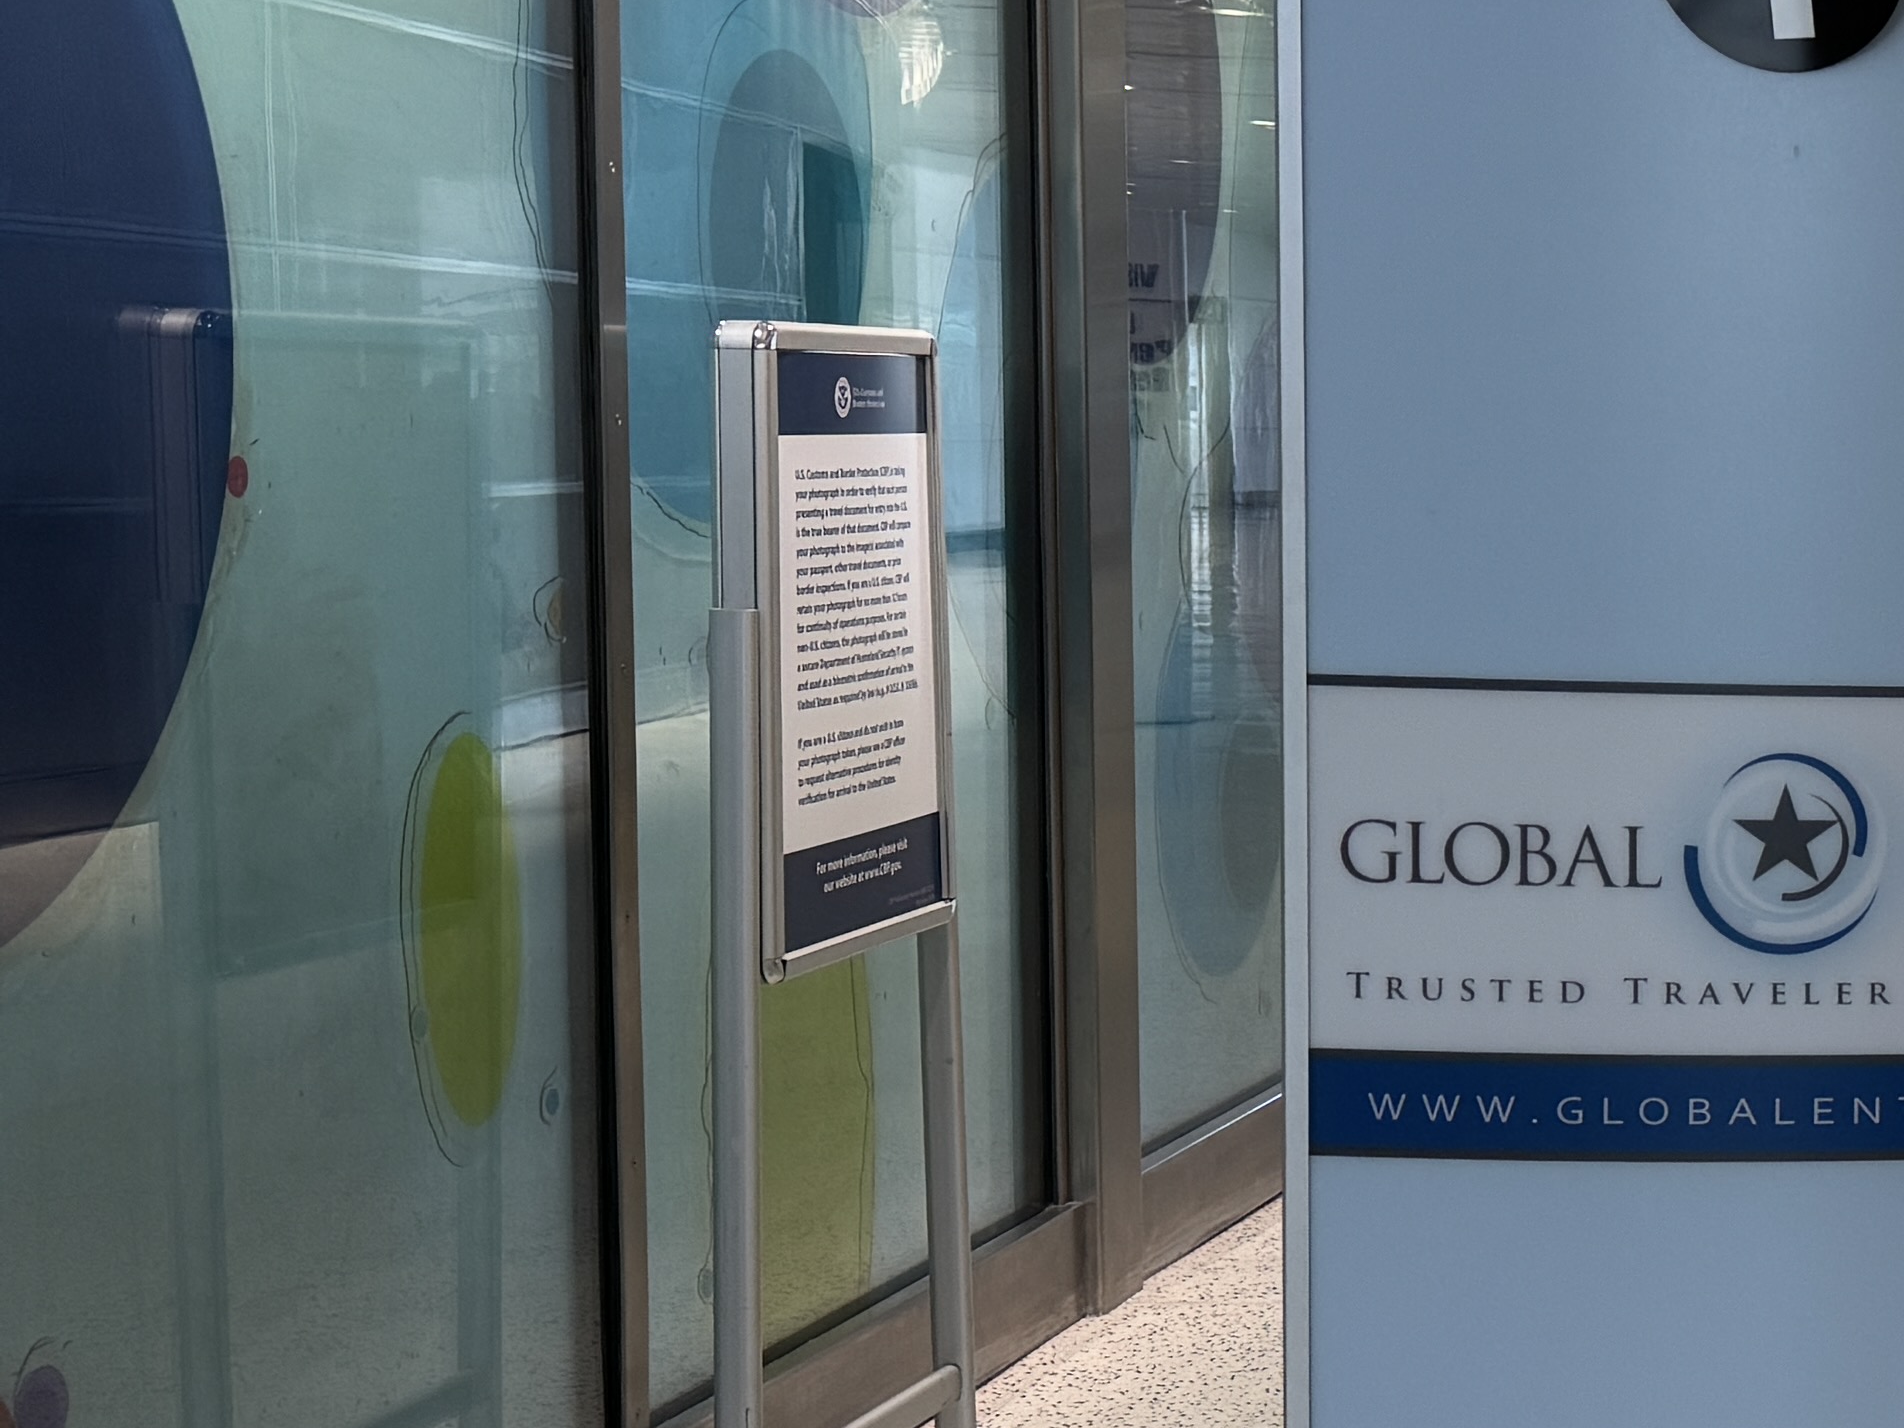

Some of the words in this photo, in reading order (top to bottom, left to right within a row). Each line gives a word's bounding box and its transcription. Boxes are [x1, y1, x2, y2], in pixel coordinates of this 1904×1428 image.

[817, 862, 826, 875] For
[828, 858, 843, 871] more
[1339, 817, 1664, 890] GLOBAL
